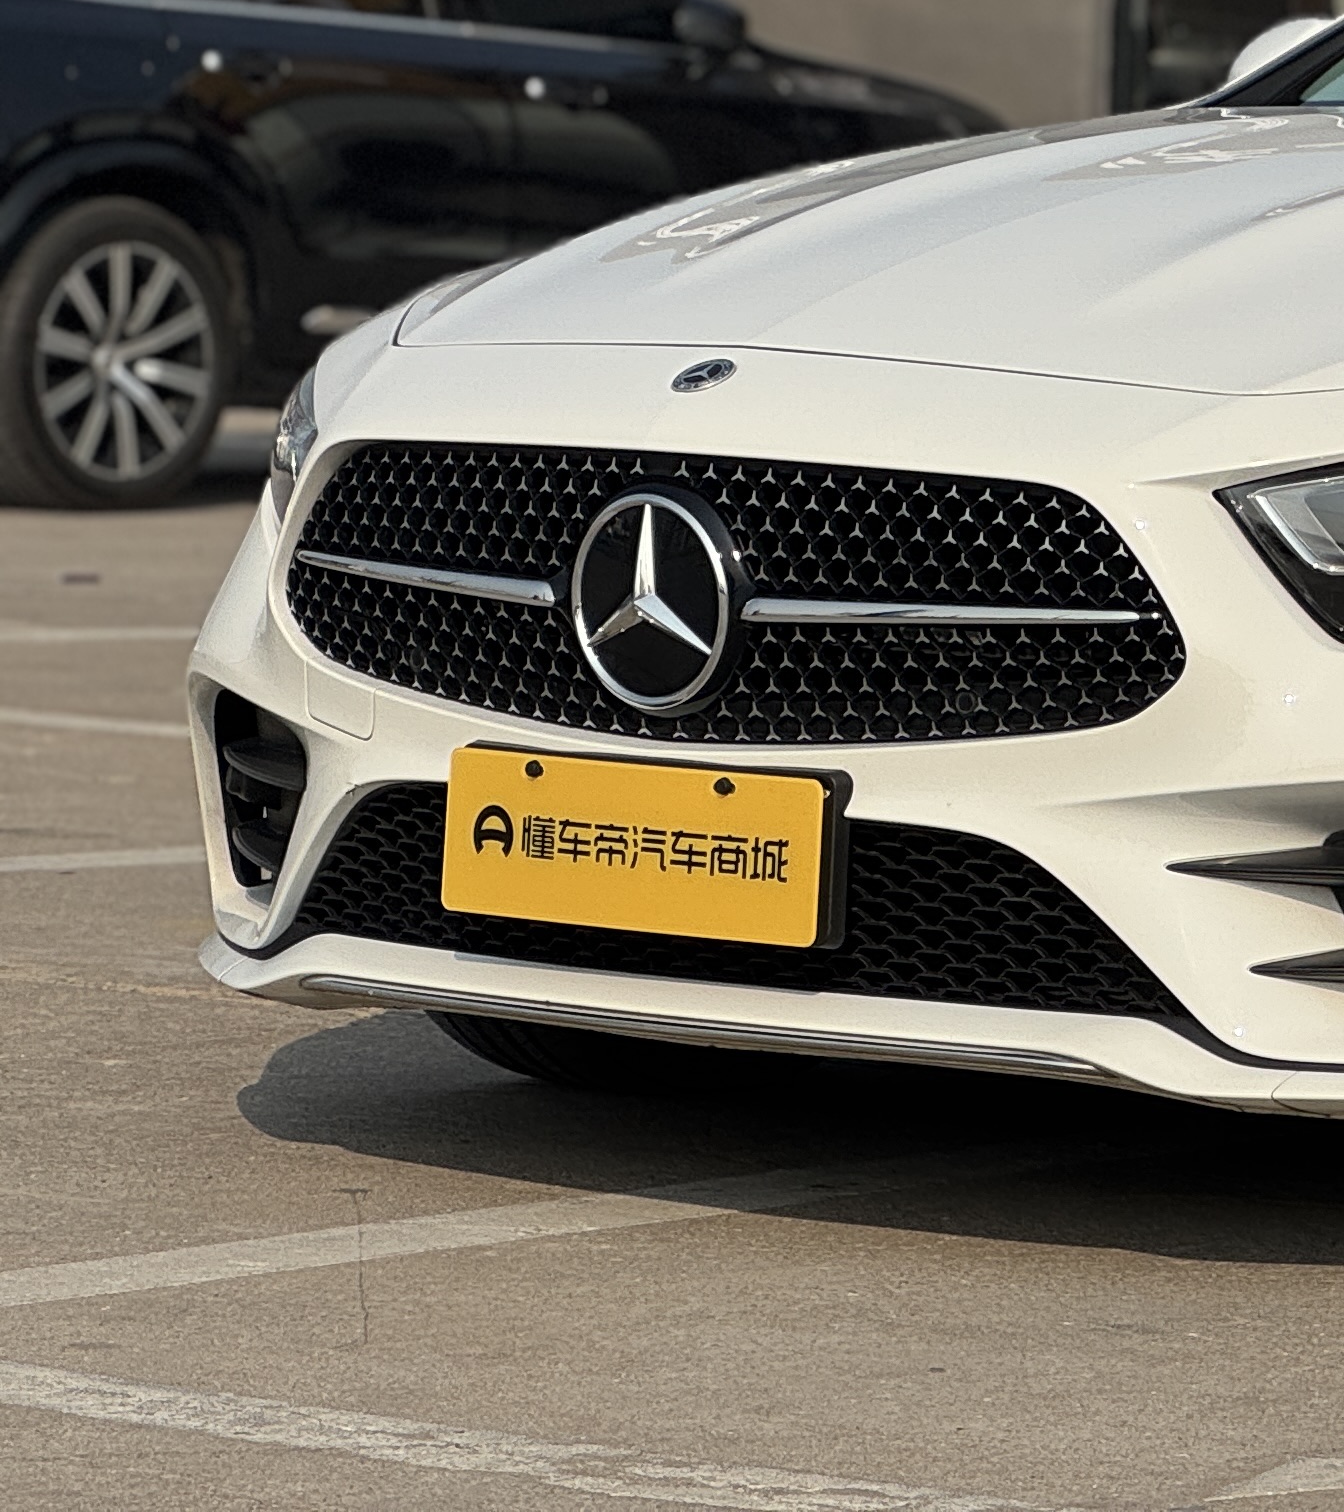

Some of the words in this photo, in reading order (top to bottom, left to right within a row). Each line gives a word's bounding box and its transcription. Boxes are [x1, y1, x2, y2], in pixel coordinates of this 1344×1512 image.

[521, 815, 791, 884] 懂车帝汽车商城
